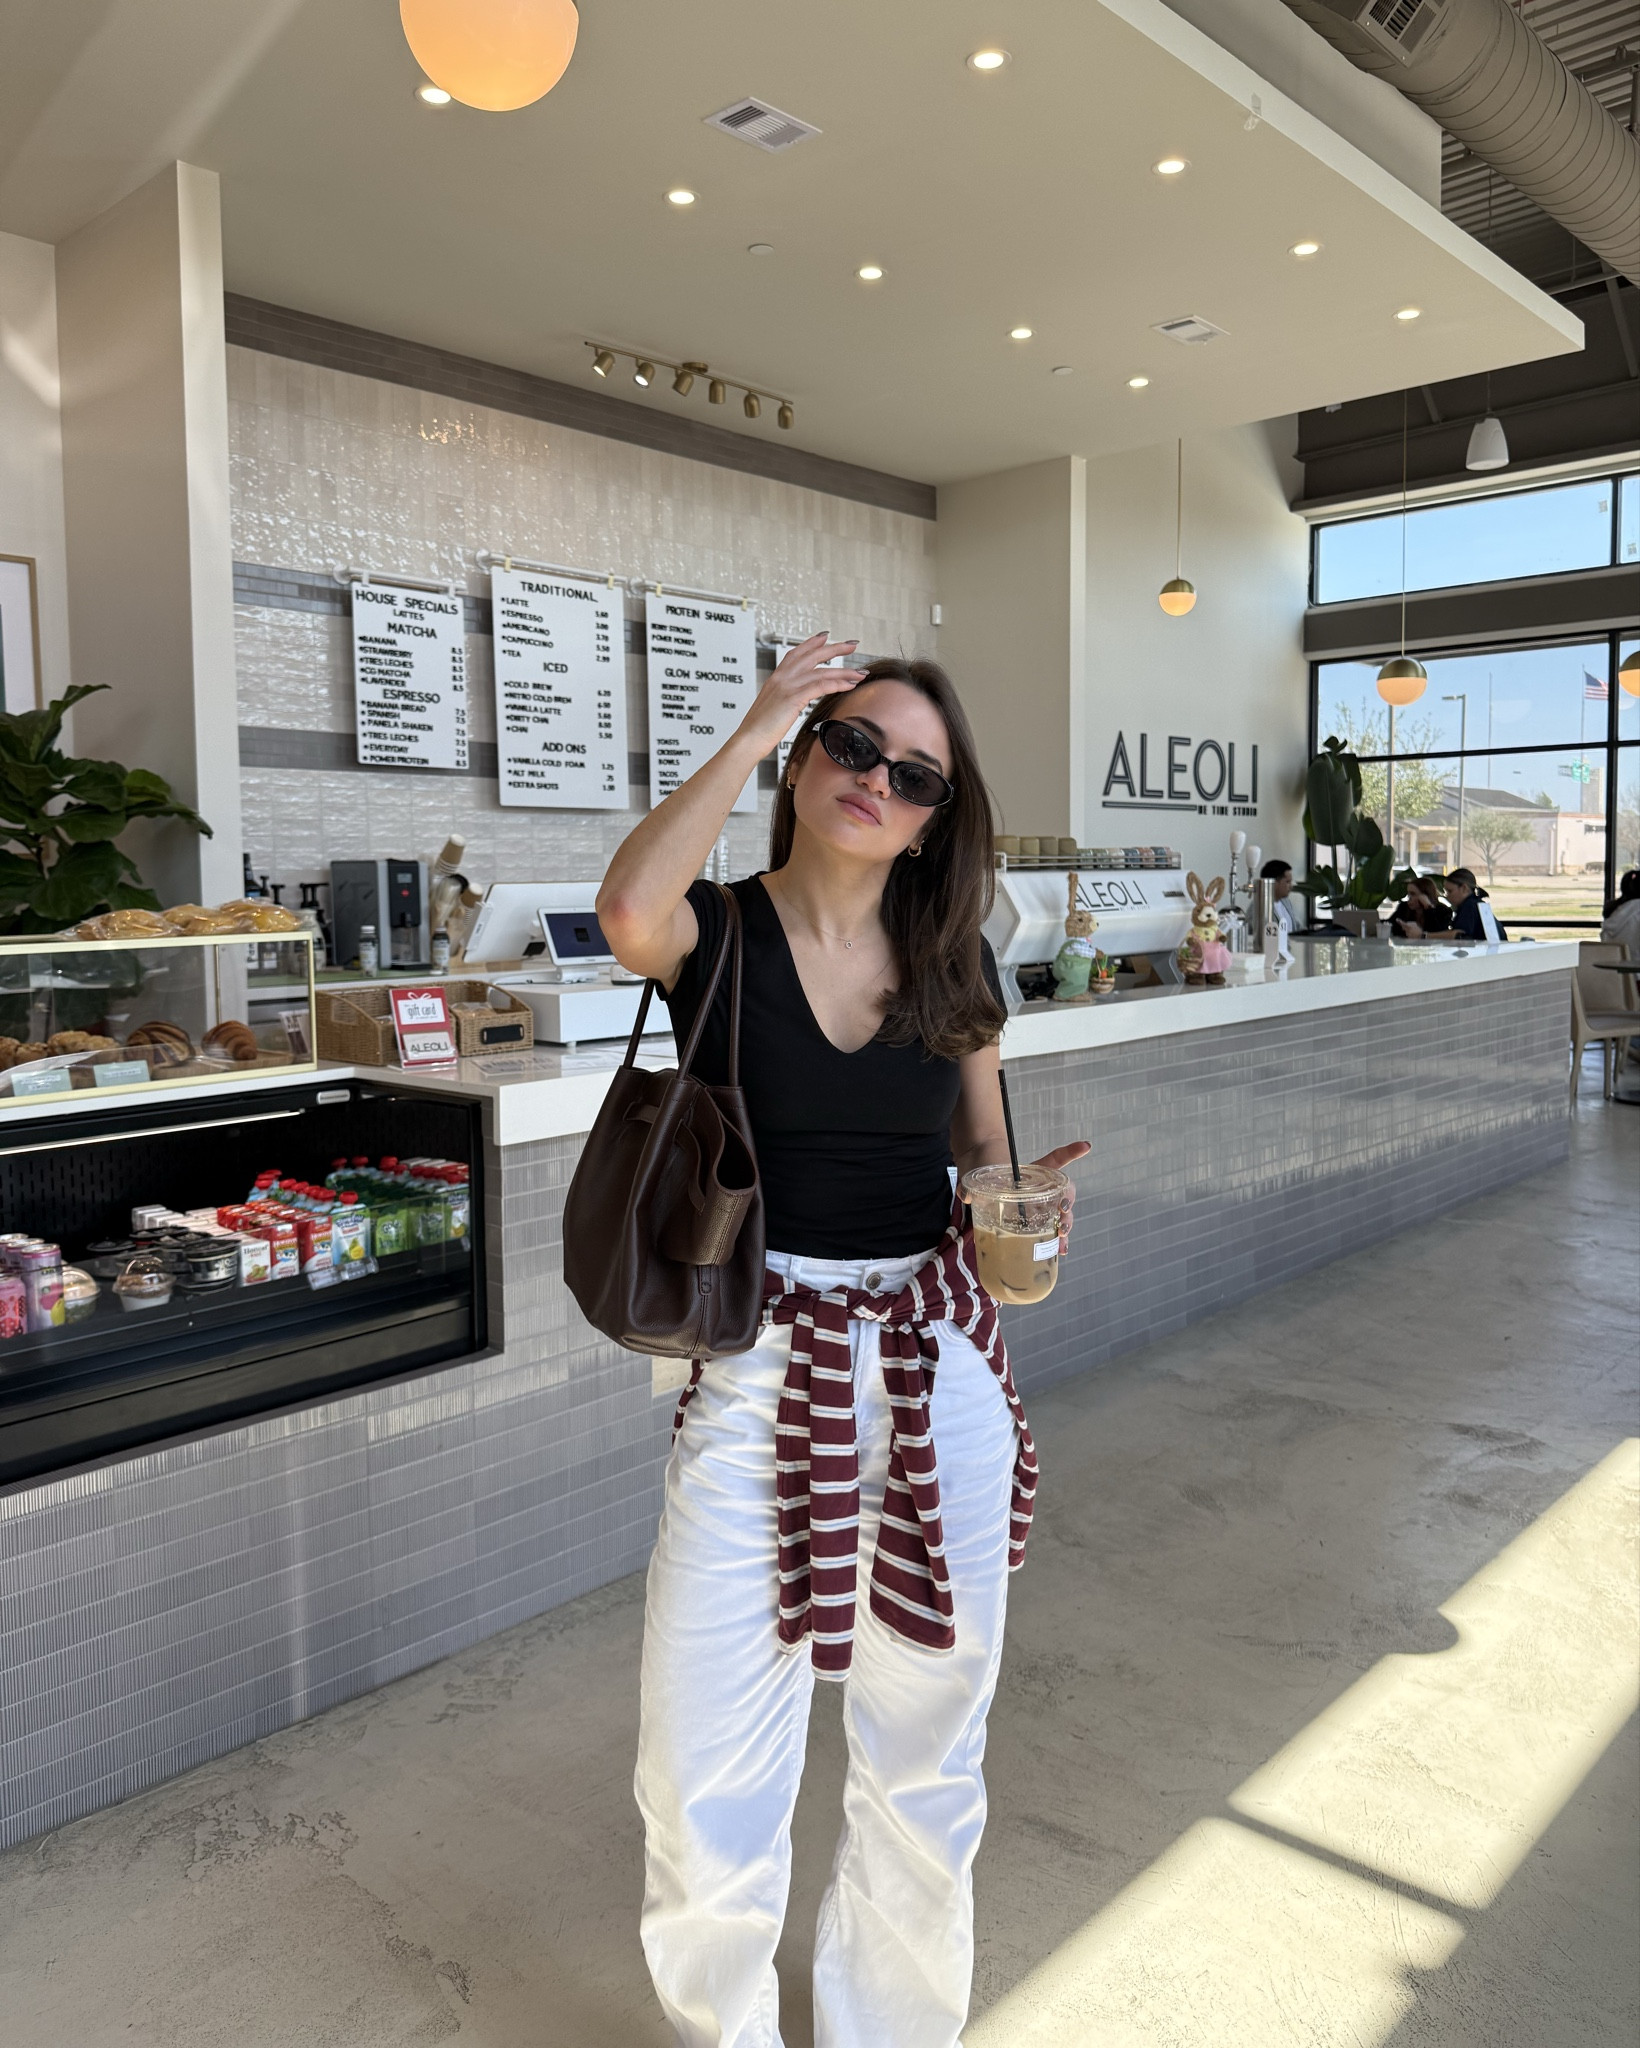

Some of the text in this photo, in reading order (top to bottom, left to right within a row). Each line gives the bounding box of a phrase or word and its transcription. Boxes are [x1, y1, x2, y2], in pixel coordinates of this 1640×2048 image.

[520, 581, 599, 603] TRADITIONAL
[355, 589, 459, 615] HOUSE SPECIALS
[506, 597, 529, 608] LATTE
[393, 609, 424, 621] LATTES
[506, 609, 544, 623] ESPRESSO
[665, 605, 735, 624] PROTEIN SHAKES
[387, 622, 438, 639] MATCHA
[506, 622, 551, 637] AMERICANO
[651, 623, 693, 635] BERRY STRONG
[363, 636, 398, 646] BANANA
[507, 635, 554, 649] CAPPUCCINO
[651, 634, 696, 646] POWER MONKEY
[363, 647, 413, 659] STRAWBERRY
[507, 649, 521, 658] TEA
[651, 646, 698, 658] MANGO MATCHA
[364, 657, 383, 667] TRES
[385, 659, 414, 669] LECHES
[543, 662, 568, 674] ICED
[377, 667, 412, 678] MATCHA
[664, 667, 744, 684] GLOW SMOOTHIES
[366, 677, 407, 687] LAVENDER
[508, 680, 530, 689] COLD
[532, 682, 552, 691] BREW
[383, 688, 441, 704] ESPRESSO
[508, 692, 531, 701] NITRO
[532, 694, 553, 703] COLD
[553, 696, 572, 704] BREW
[661, 693, 686, 702] GOLDEN
[366, 701, 466, 717] BANANA BREAD 7.5
[509, 704, 538, 713] VANILLA
[540, 707, 562, 716] LATTE
[661, 703, 685, 711] BANANA
[366, 709, 400, 720] SPANISH
[510, 714, 530, 723] DIRTY
[532, 715, 549, 724] CHAI
[662, 711, 693, 721] PINK GLOW
[367, 719, 466, 737] PANELA SHAKEN 7.5
[511, 725, 528, 733] CHAI
[690, 724, 714, 735] FOOD
[368, 731, 466, 747] TRES LECHES 7.5
[369, 743, 466, 757] EVERYDAY 7.5
[542, 741, 587, 755] ADD ONS
[370, 755, 396, 763] POWER
[397, 756, 430, 765] PROTEIN
[512, 757, 541, 766] VANILLA
[542, 759, 562, 768] COLD
[564, 760, 586, 769] FOAM
[1102, 730, 1258, 803] ALEOLI
[512, 769, 525, 777] ALT
[528, 770, 545, 778] MILK
[512, 781, 535, 789] EXTRA
[536, 782, 559, 790] SHOTS
[1212, 805, 1229, 816] TIME
[1232, 806, 1257, 817] STUDIO
[408, 1003, 436, 1019] gift card
[411, 1042, 448, 1052] ALEOLI
